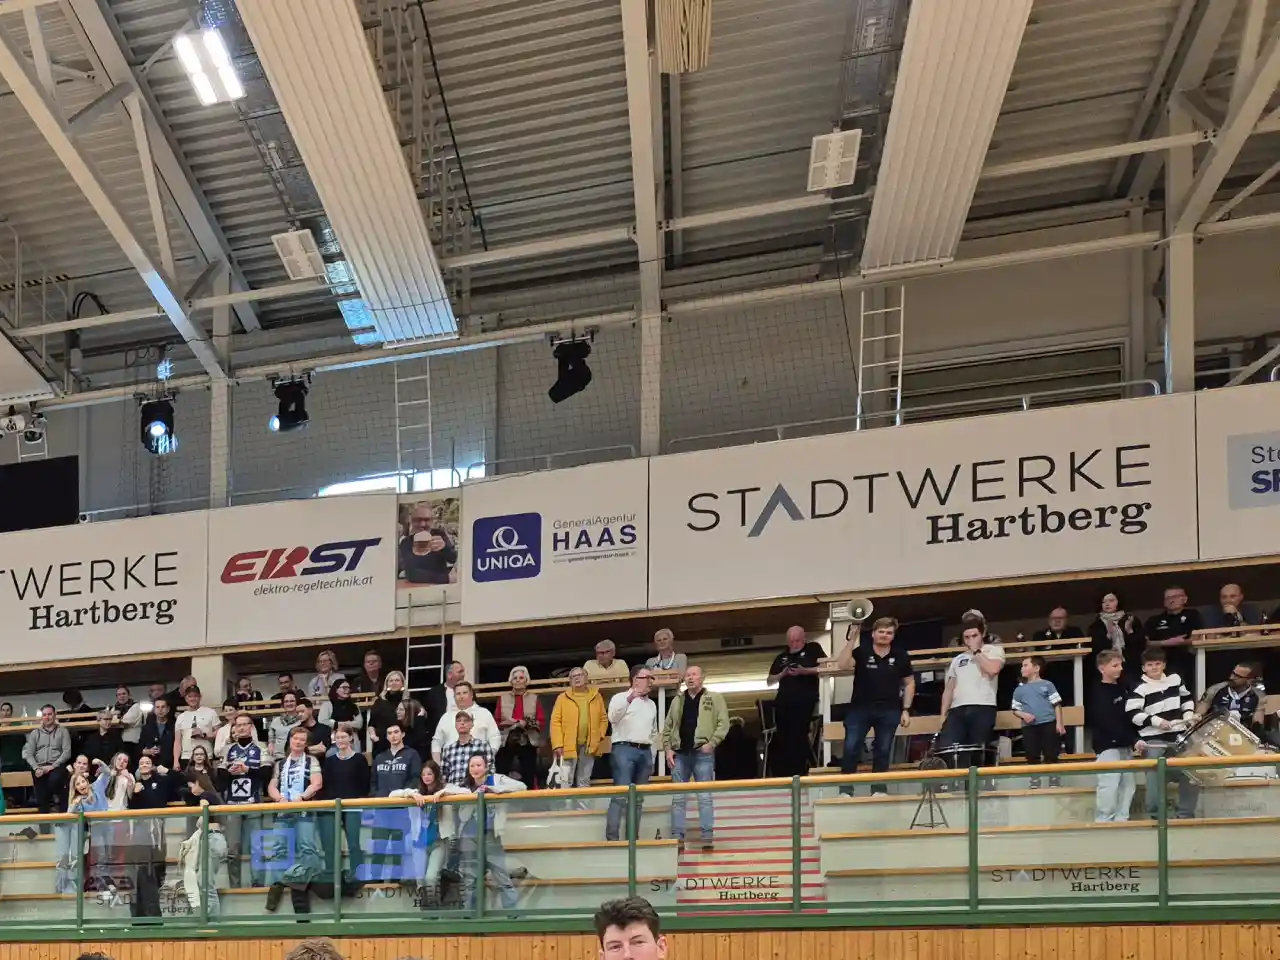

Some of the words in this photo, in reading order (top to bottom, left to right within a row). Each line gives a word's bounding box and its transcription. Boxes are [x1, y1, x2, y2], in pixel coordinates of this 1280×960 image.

[687, 443, 1153, 537] STADTWERKE
[553, 513, 637, 529] GeneralAgentur
[926, 496, 1152, 546] Hartberg
[552, 524, 637, 551] HAAS
[477, 553, 536, 571] UNIQA
[253, 575, 375, 596] elektro-regeltechnik.at
[29, 598, 178, 630] Hartberg
[991, 866, 1141, 883] STADTWERKE
[650, 876, 780, 895] STADTWERKE
[1070, 881, 1141, 893] Hartberg
[719, 891, 779, 900] Hartberg
